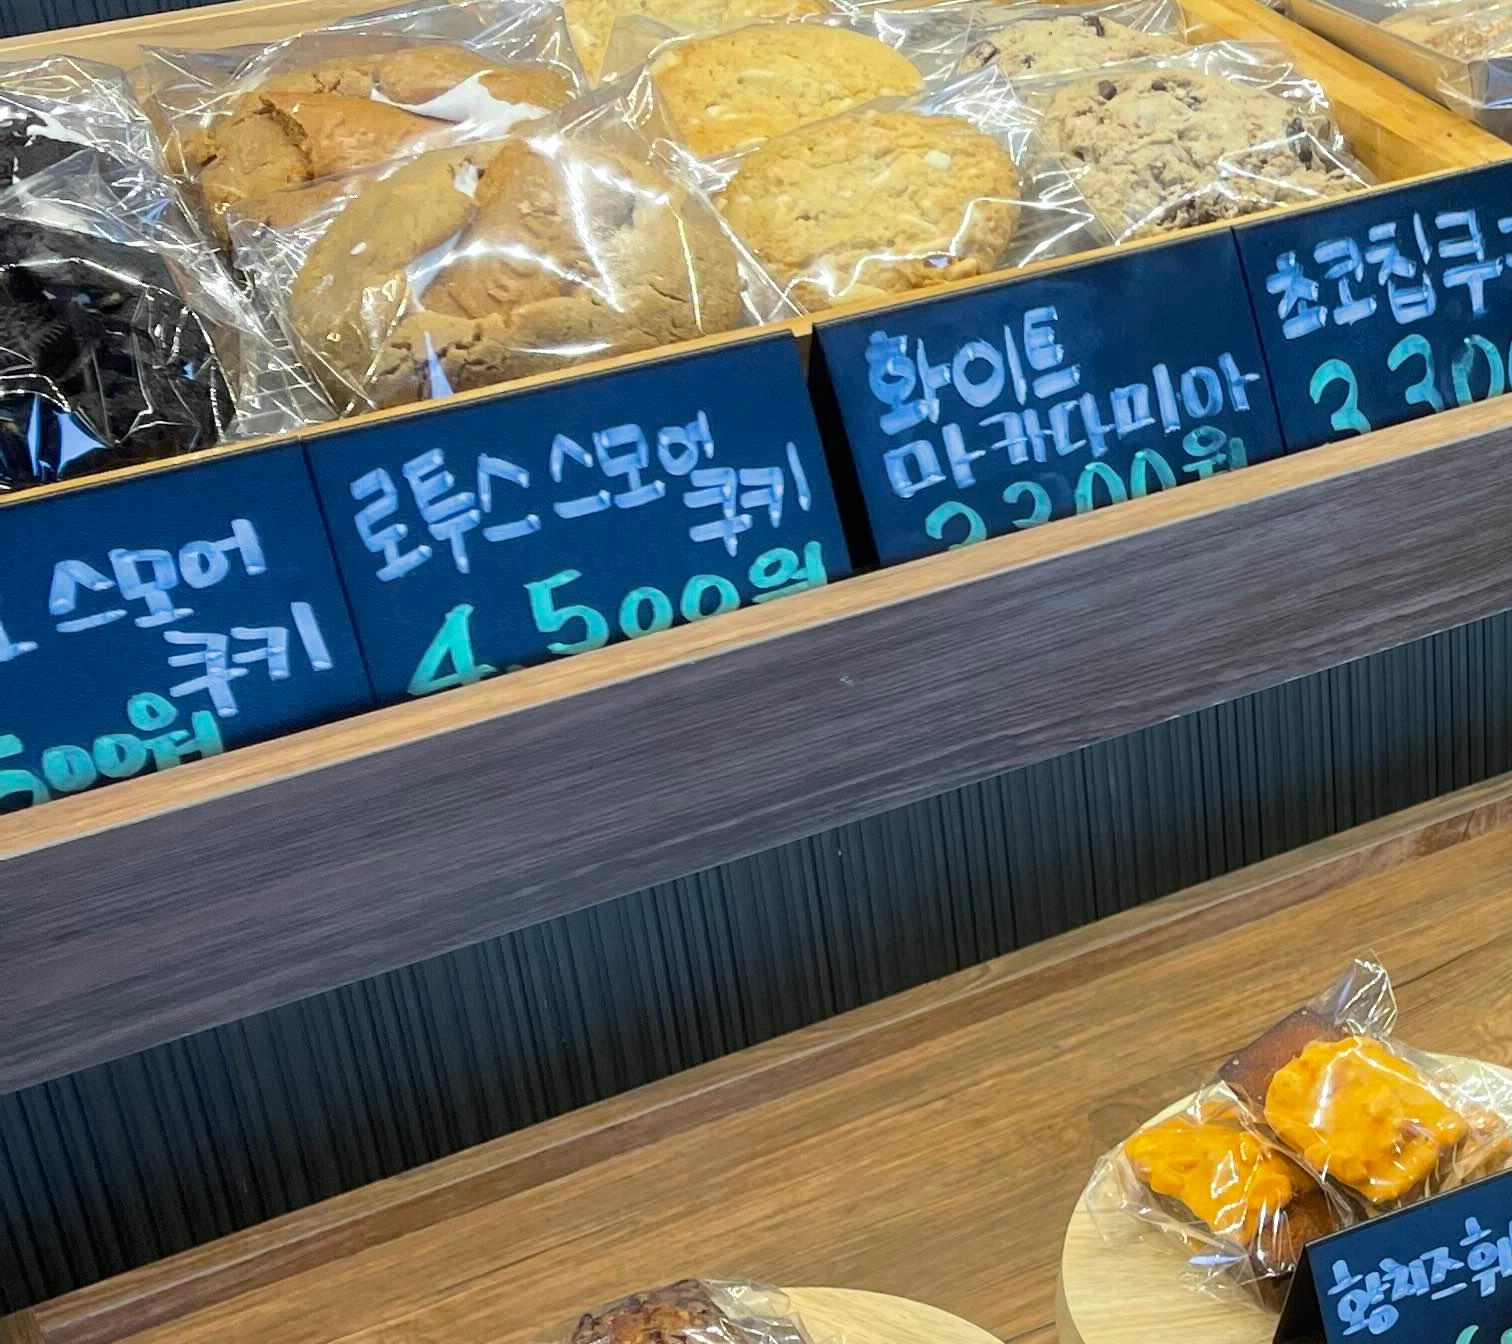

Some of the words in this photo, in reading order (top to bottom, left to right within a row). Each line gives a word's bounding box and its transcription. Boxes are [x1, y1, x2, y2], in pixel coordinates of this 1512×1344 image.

[865, 305, 1081, 437] 화이트
[883, 352, 1261, 499] 마카다미아
[350, 447, 542, 583] 로투스
[550, 410, 716, 519] 스모어
[683, 441, 813, 557] 쿠키
[49, 518, 269, 633] 스모어
[163, 601, 334, 717] 쿠키
